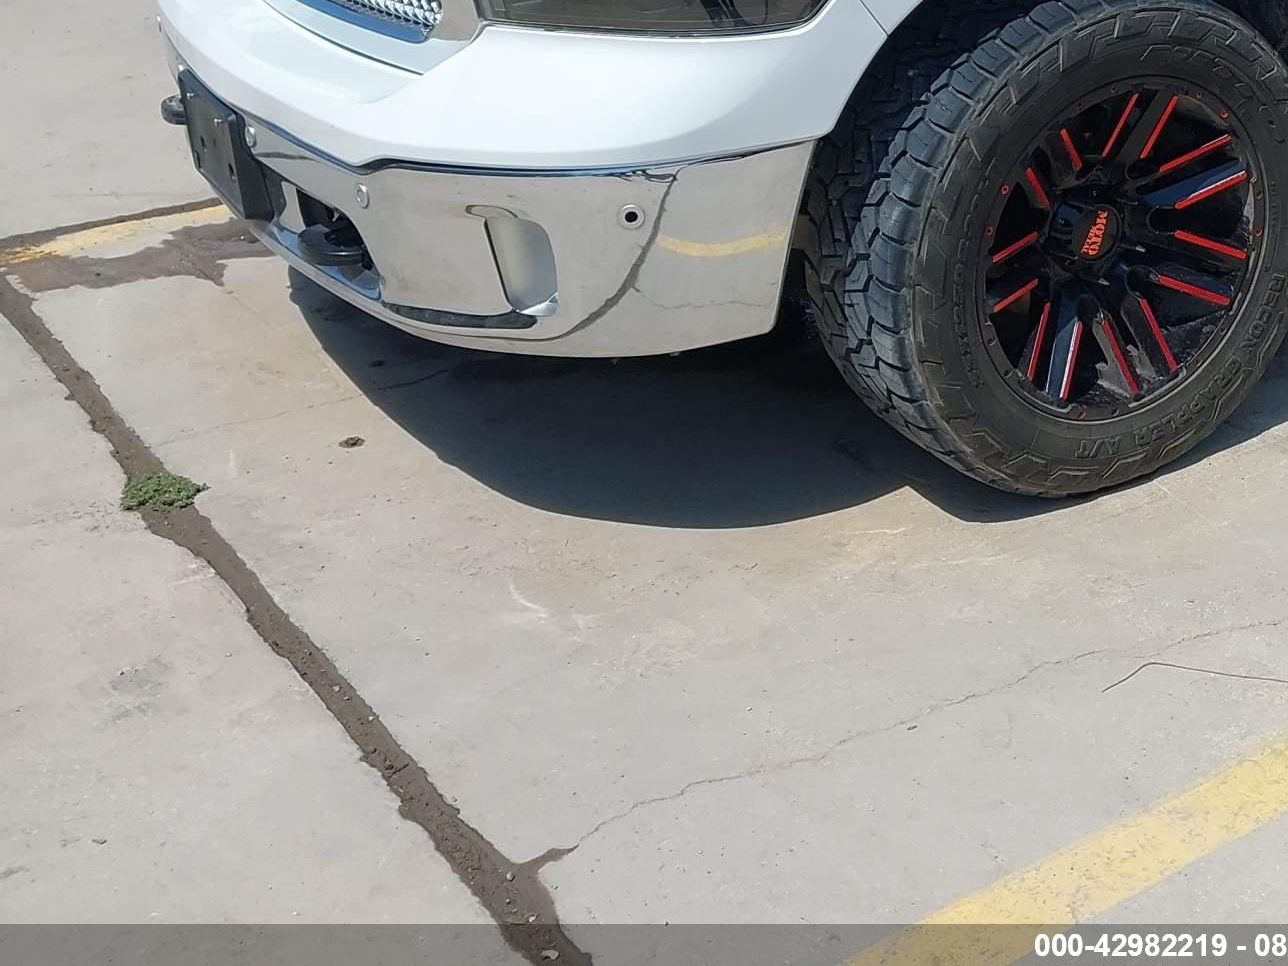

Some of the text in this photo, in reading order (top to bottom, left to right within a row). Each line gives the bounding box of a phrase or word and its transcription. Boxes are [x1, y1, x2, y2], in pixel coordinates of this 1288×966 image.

[1088, 210, 1108, 256] MOTO
[1074, 273, 1288, 459] RECON GRAPPLER A/T
